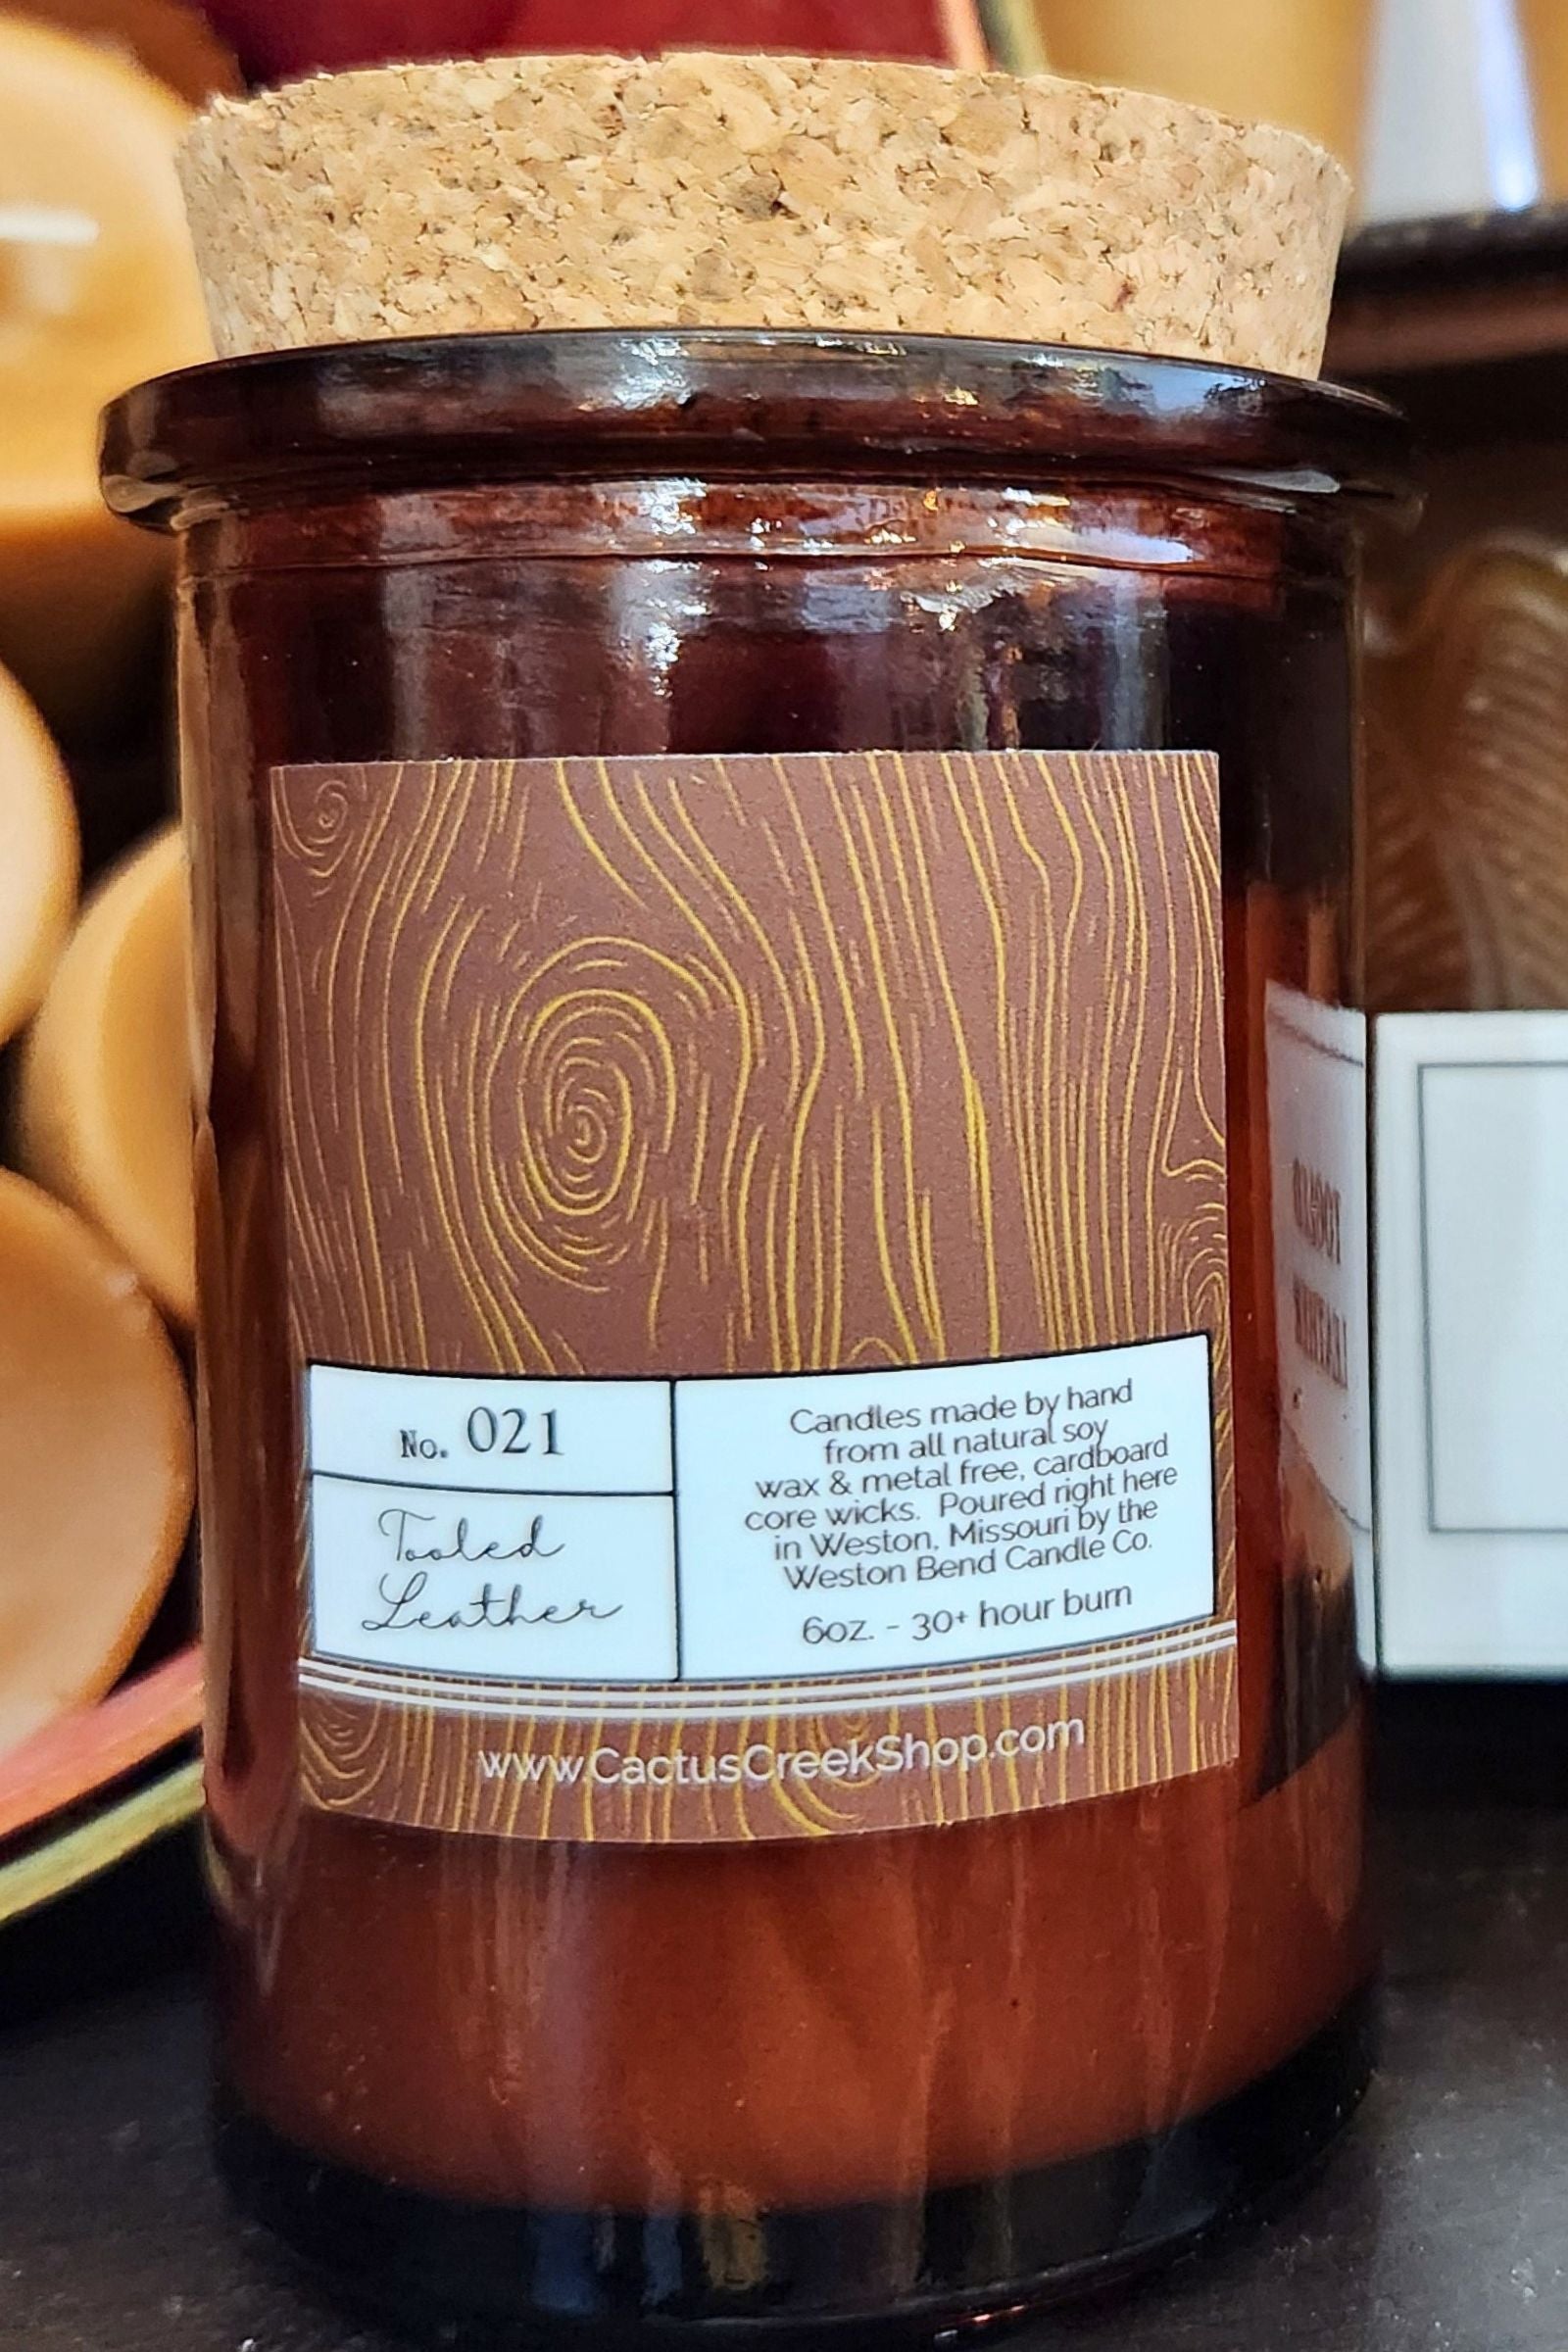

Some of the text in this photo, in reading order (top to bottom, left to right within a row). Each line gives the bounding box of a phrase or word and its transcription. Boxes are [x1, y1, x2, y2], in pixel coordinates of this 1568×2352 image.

[400, 1405, 564, 1459] No. 021
[790, 1378, 1133, 1434] Candles made by hand
[755, 1432, 1169, 1498] wax & metal free, cardboard
[824, 1419, 1108, 1464] from all natural soy
[745, 1466, 1178, 1531] core wicks. Poured right here
[773, 1497, 1158, 1560] in Weston, Missouri by the
[377, 1507, 565, 1562] Tooled
[783, 1529, 1152, 1590] Weston Bend Candle Co.
[362, 1570, 624, 1632] Leather
[803, 1615, 875, 1644] 6oz.
[911, 1609, 968, 1642] 30+
[979, 1597, 1055, 1628] hour
[1063, 1585, 1132, 1616] burn
[477, 1715, 1085, 1786] www.CactusCreekShop.com
